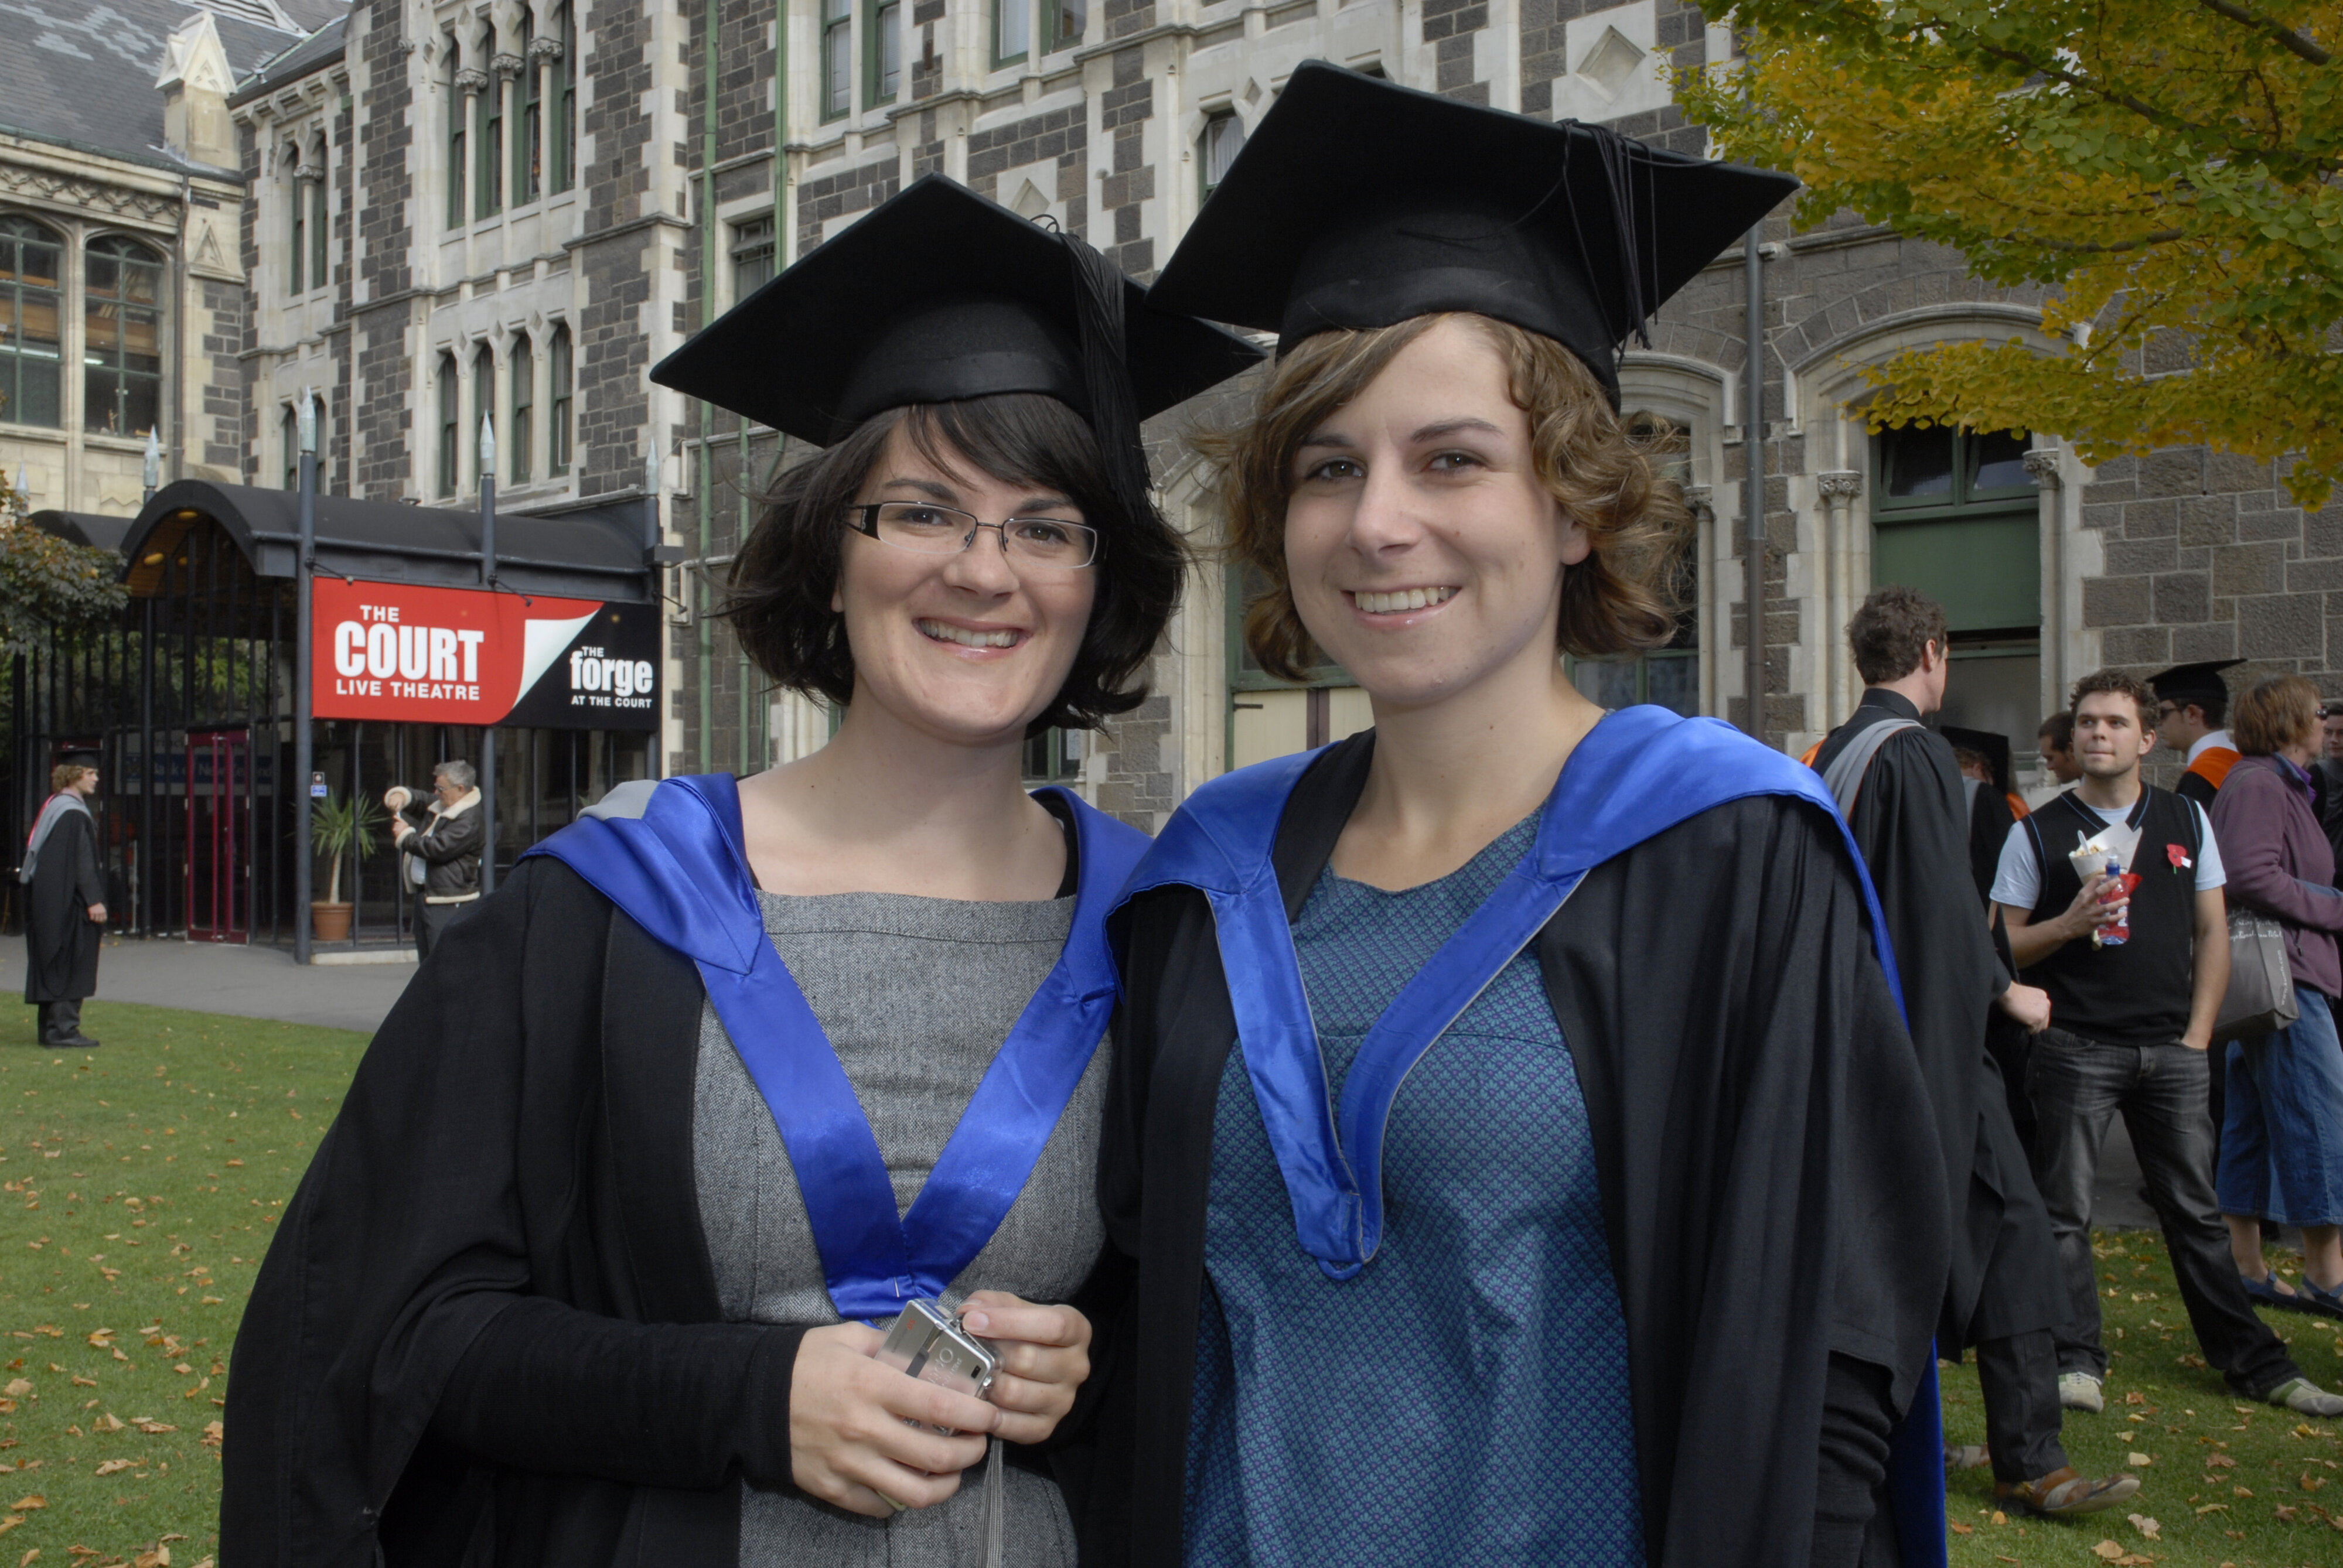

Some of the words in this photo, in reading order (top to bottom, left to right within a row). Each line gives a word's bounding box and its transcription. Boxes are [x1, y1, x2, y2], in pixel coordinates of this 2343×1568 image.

[360, 604, 400, 623] THE
[335, 620, 485, 682] COURT
[581, 646, 604, 657] THE
[570, 650, 653, 697] forge
[336, 679, 382, 696] LIVE
[390, 681, 480, 701] THEATRE
[571, 695, 586, 705] AT
[589, 695, 611, 707] THE
[615, 697, 652, 708] COURT
